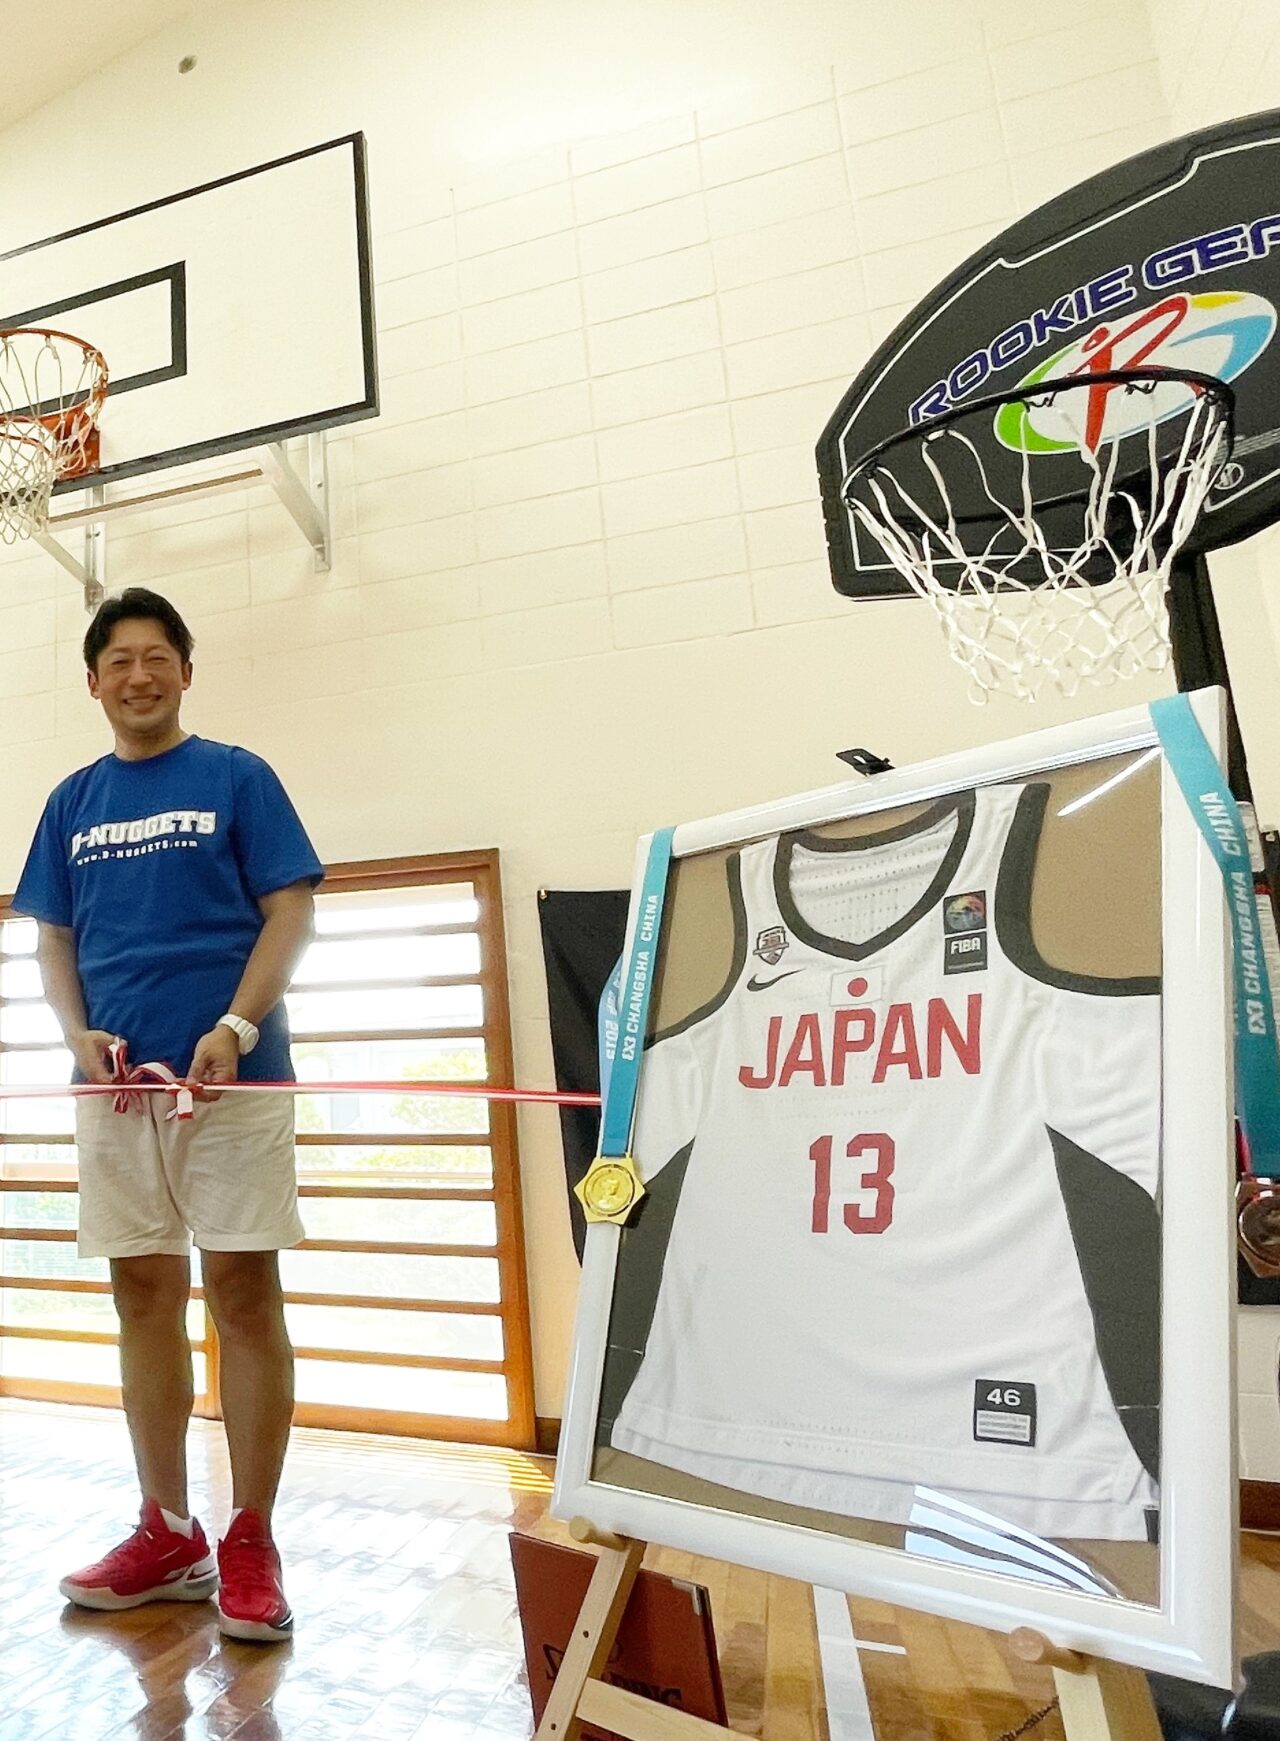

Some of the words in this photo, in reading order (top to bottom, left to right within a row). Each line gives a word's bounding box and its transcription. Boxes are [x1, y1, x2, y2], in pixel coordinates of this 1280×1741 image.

[908, 265, 1137, 427] ROOKIE
[71, 810, 216, 857] D-NUGGETS
[1199, 791, 1242, 857] CHINA
[626, 951, 650, 1034] CHANGSHA
[640, 895, 658, 942] CHINA
[950, 936, 981, 955] FIBA
[1230, 871, 1261, 995] CHANGSHA
[737, 992, 982, 1090] JAPAN
[808, 1132, 896, 1235] 13
[986, 1388, 1021, 1407] 46
